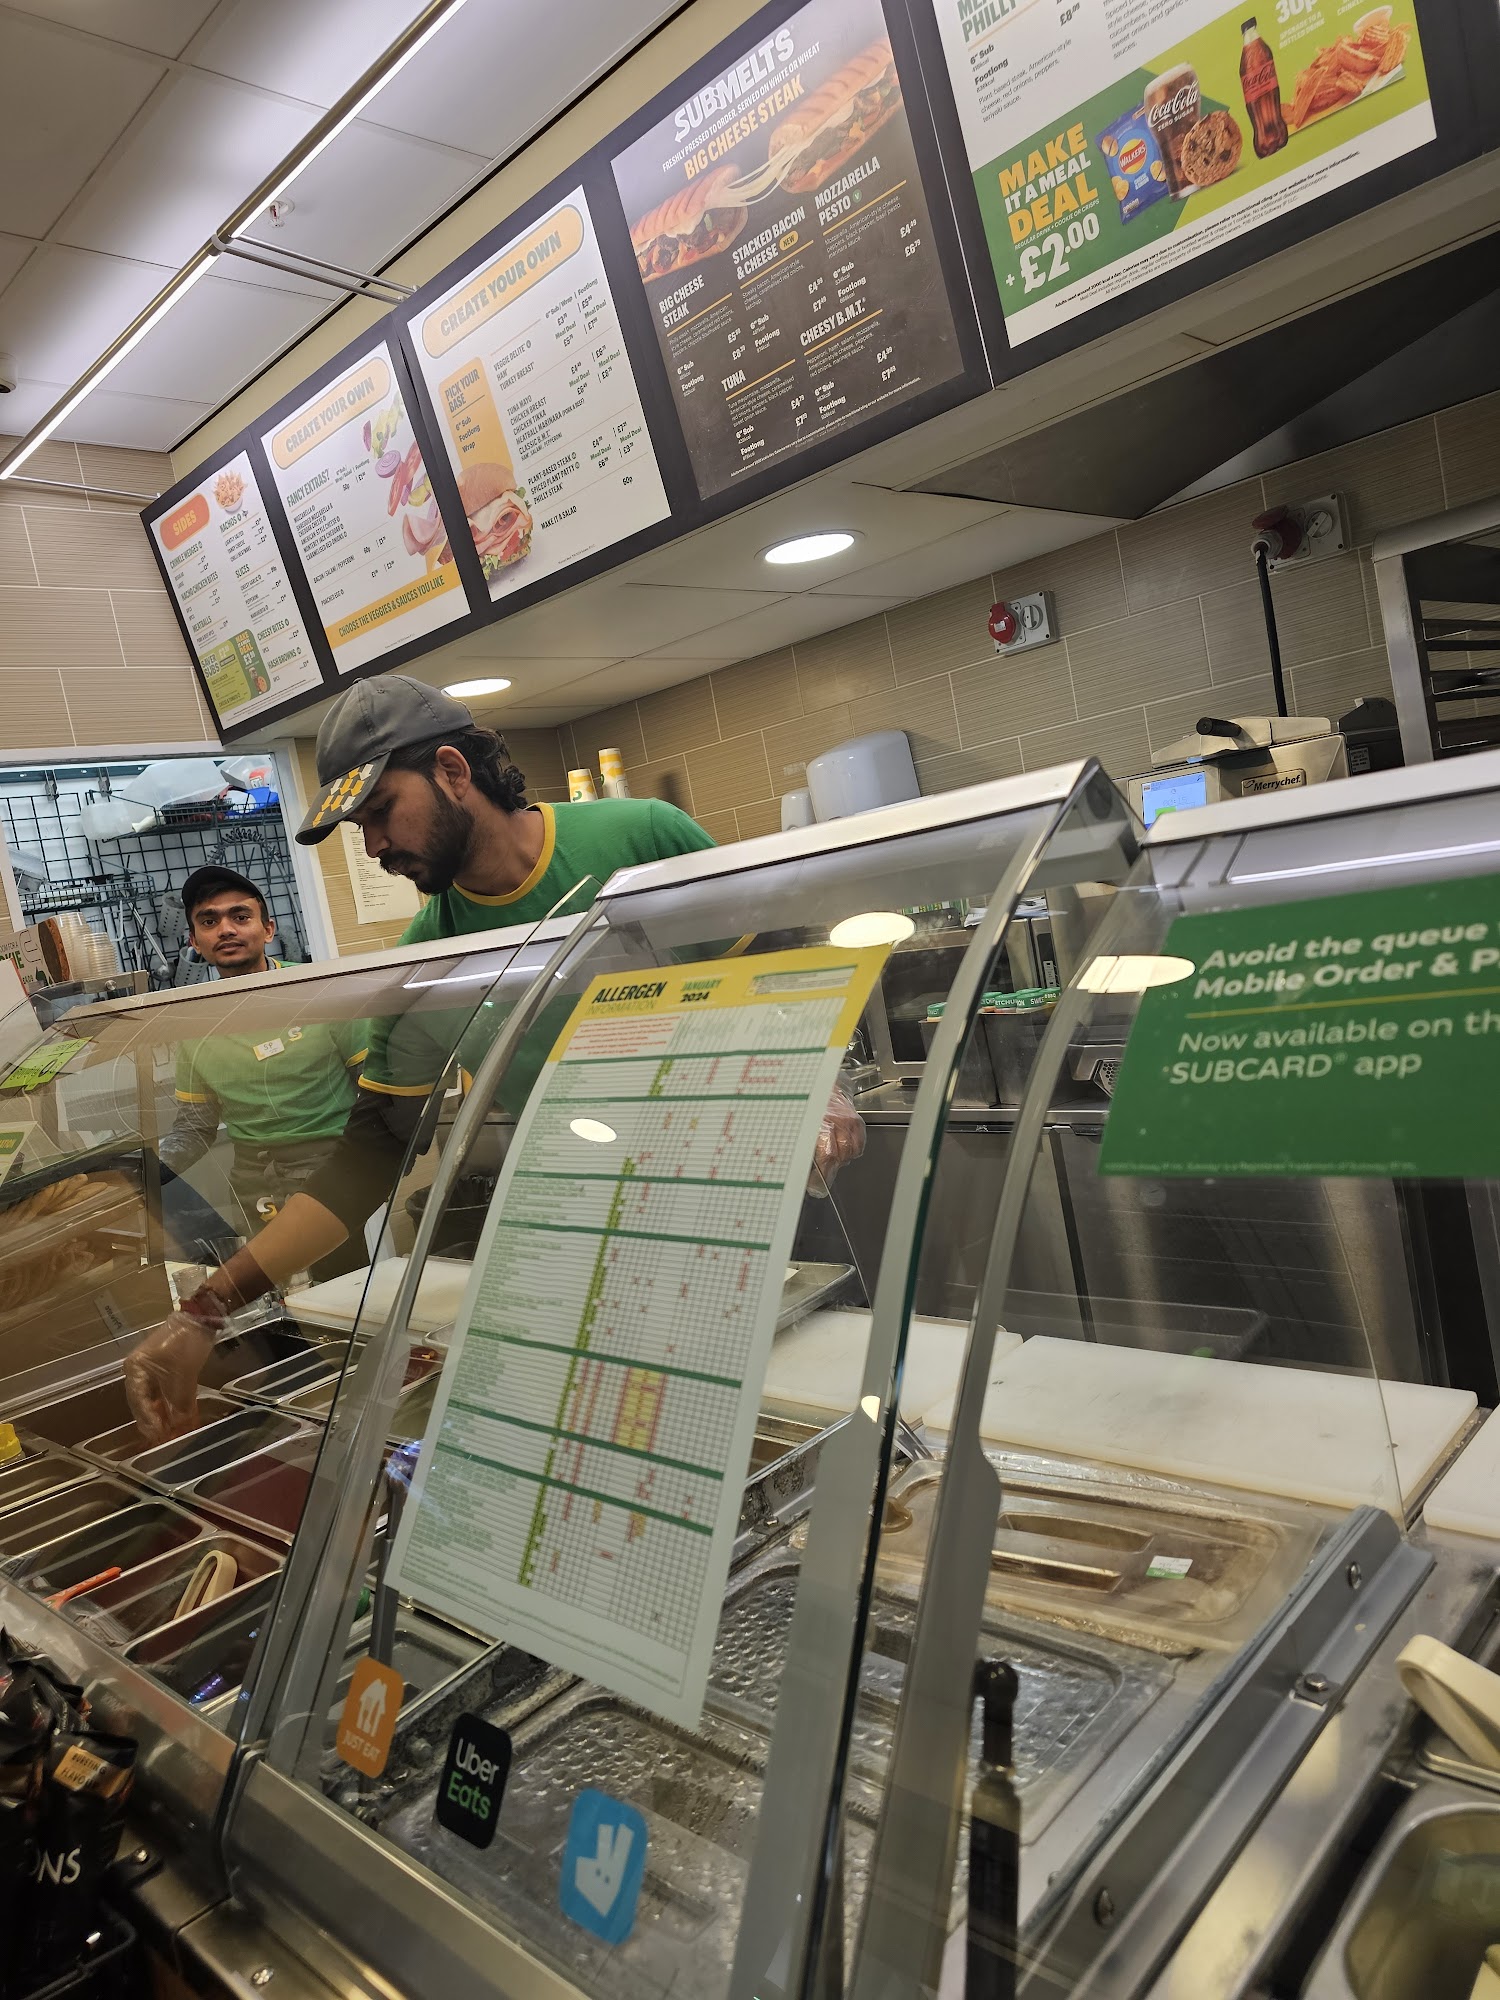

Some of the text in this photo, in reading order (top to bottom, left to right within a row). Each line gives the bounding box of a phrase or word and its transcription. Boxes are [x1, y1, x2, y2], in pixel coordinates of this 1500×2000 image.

[1150, 10, 1163, 24] and
[978, 41, 994, 60] Sub
[974, 53, 1008, 89] Footlong
[662, 147, 685, 172] FRESHLY
[684, 128, 710, 155] PRESSED
[708, 123, 717, 136] TO
[736, 88, 760, 113] SERVED
[759, 80, 770, 96] ON
[769, 66, 789, 88] WHITE
[788, 58, 799, 73] OR
[797, 41, 821, 66] WHEAT
[683, 72, 804, 180] BIG CHEESE STEAK
[998, 122, 1087, 197] MAKE
[1120, 144, 1146, 168] WALKERS
[814, 154, 880, 210] MOZZARELLA
[1004, 147, 1091, 214] IT A MEAL
[817, 193, 852, 226] PESTO
[1007, 164, 1098, 246] DEAL
[731, 205, 805, 265] STACKED BACON
[1014, 233, 1036, 251] REGULAR
[1036, 225, 1051, 238] DRINK
[1054, 212, 1073, 228] COOKIE
[1081, 197, 1099, 213] CRISPS
[735, 234, 795, 280] & CHEESE NEW
[840, 259, 854, 274] Sub
[438, 229, 562, 338] CREATE YOUR OWN
[658, 273, 704, 314] BIG CHEESE
[837, 274, 866, 299] Footlong
[662, 301, 689, 328] STEAK
[757, 312, 769, 325] Sub
[754, 326, 780, 348] Footlong
[799, 314, 837, 347] CHEESY
[493, 354, 509, 371] VEGGIE
[683, 359, 694, 371] Sub
[444, 367, 479, 401] PICK YOUR
[499, 374, 517, 391] TURKEY
[681, 372, 704, 392] Footlong
[721, 368, 746, 392] TUNA
[821, 379, 835, 392] Sub
[284, 374, 375, 454] CREATE YOUR OWN
[448, 392, 466, 413] BASE
[506, 394, 532, 416] TUNA MAYO
[509, 396, 547, 426] CHICKEN BREAST
[818, 394, 846, 414] Footlong
[458, 423, 480, 443] Footlong
[461, 415, 471, 427] Sub
[512, 408, 546, 435] CHICKEN TIKKA
[515, 410, 562, 445] MEATBALL MARINARA
[742, 423, 754, 435] Sub
[461, 439, 475, 454] Wrap
[518, 438, 537, 454] CLASSIC
[740, 437, 765, 456] Footlong
[527, 454, 572, 485] PLANT-BASED STEAK
[286, 486, 305, 507] FANCY
[303, 468, 330, 495] EXTRAS?
[530, 480, 547, 495] SPICED
[546, 472, 561, 486] PLANT
[533, 490, 548, 504] PHILLY
[171, 508, 197, 536] SIDES
[219, 515, 237, 533] NACHOS
[540, 517, 554, 529] MAKE
[561, 505, 577, 518] SALAD
[235, 563, 250, 578] SLICES
[338, 574, 445, 637] CHOOSE THE VEGGIES & SAUCES YOU LIKE
[256, 619, 284, 641] CHEESY BITES
[200, 653, 217, 668] SAVER
[204, 663, 220, 678] SUBS
[267, 648, 296, 669] HASH BROWNS
[1200, 922, 1489, 972] Avoid the queue
[1194, 946, 1500, 1000] Mobile Order & P
[591, 978, 724, 1004] ALLERGEN JANUARY
[585, 1000, 658, 1016] INFORMATION
[1178, 1031, 1249, 1055] Now
[1253, 1017, 1399, 1050] available
[1408, 1016, 1454, 1039] on
[1353, 1052, 1423, 1081] app
[342, 1730, 381, 1762] JUST EAT
[72, 1753, 107, 1775] BURSTING
[455, 1737, 499, 1785] Uber
[447, 1770, 491, 1821] Eats
